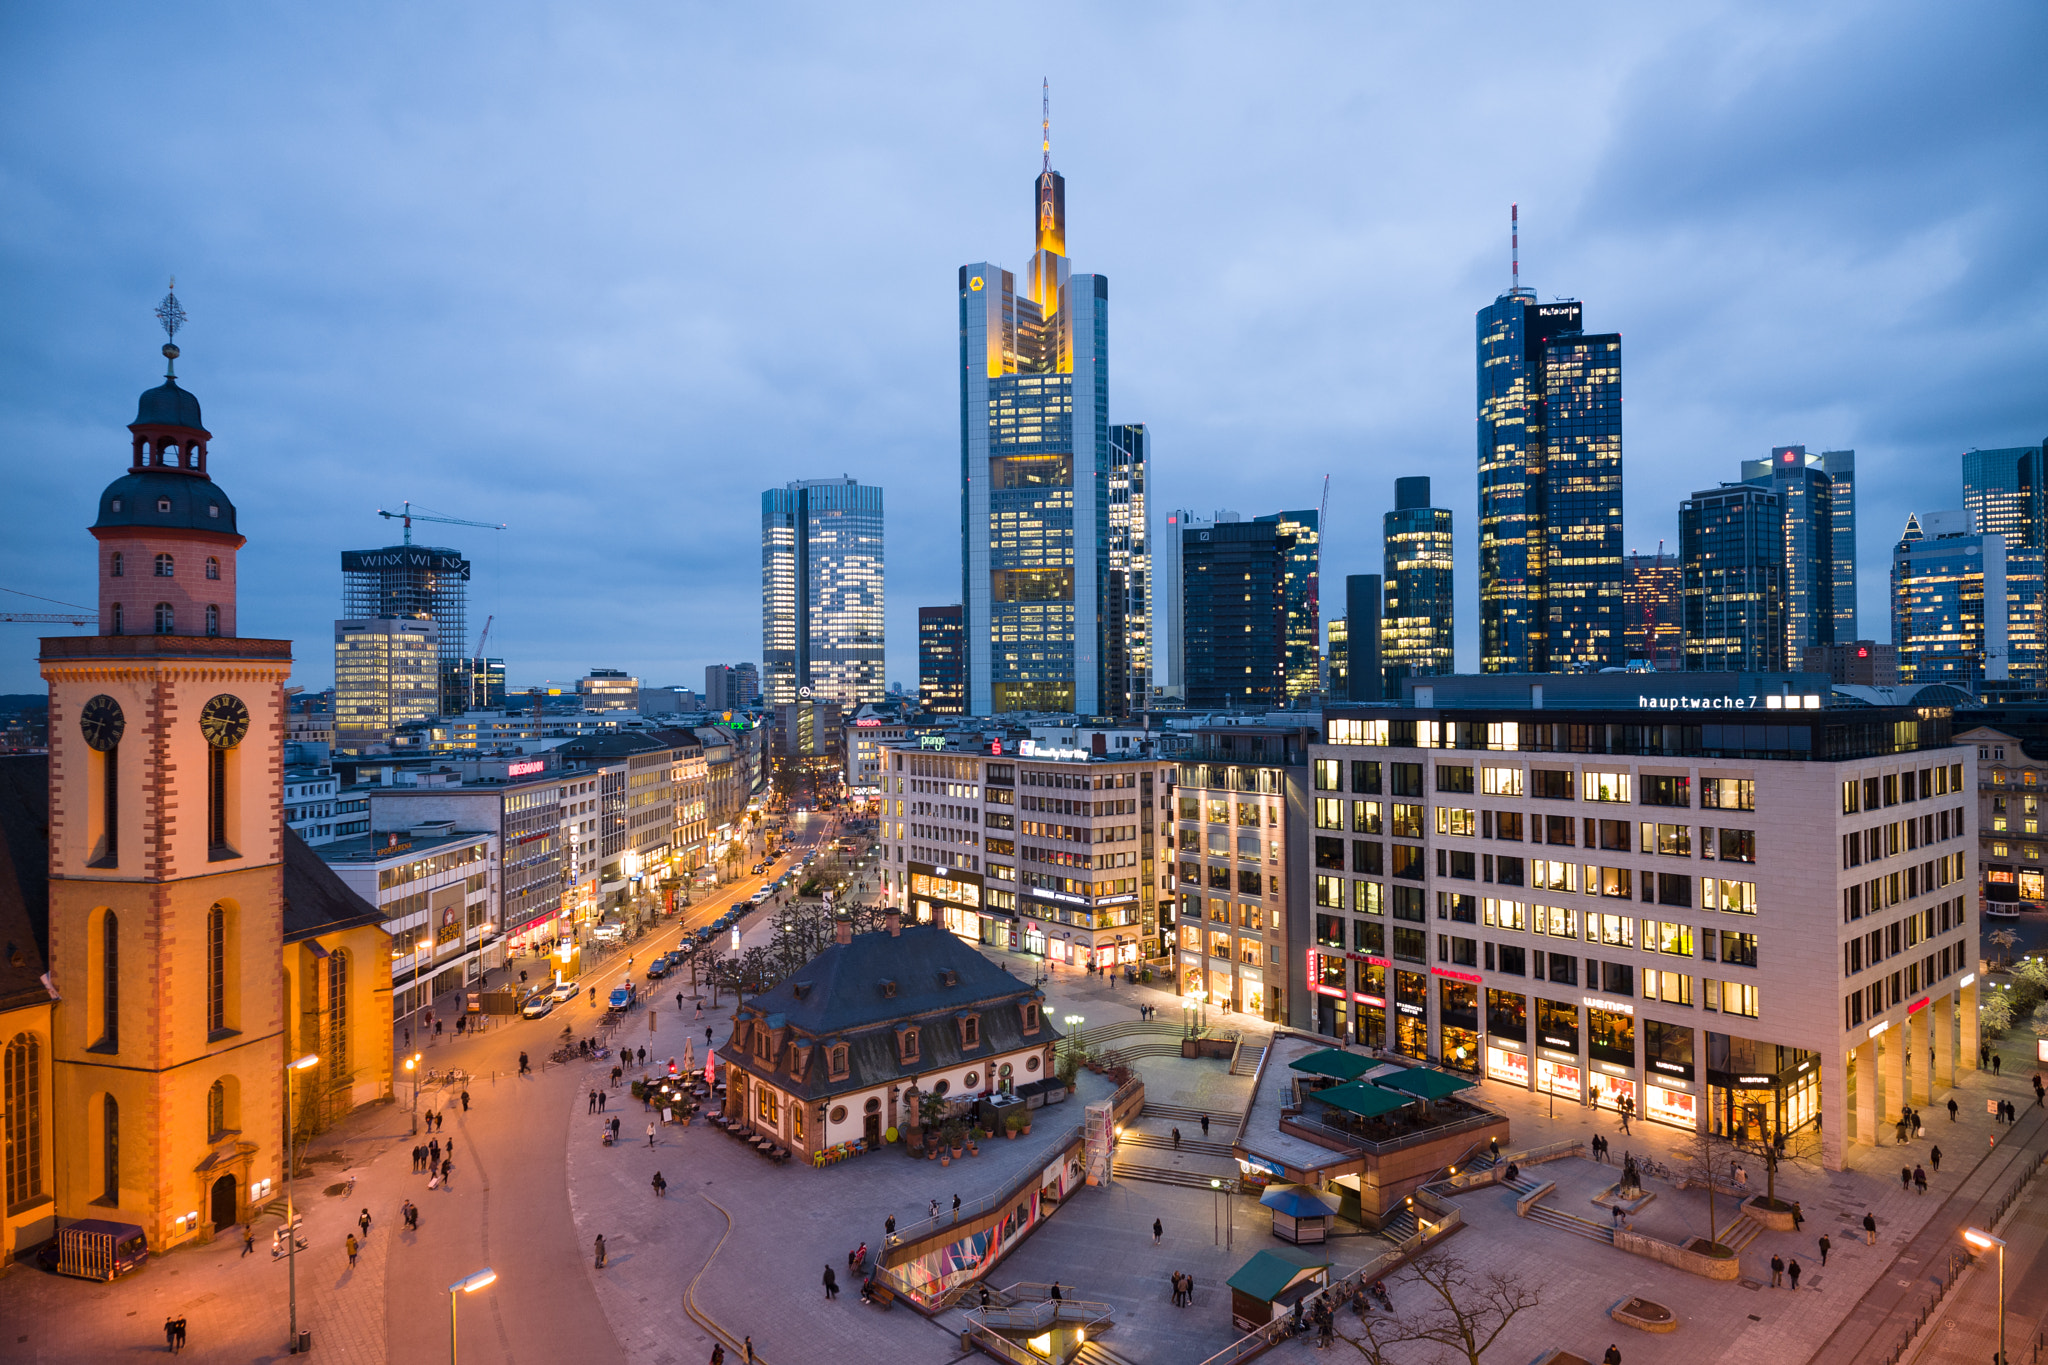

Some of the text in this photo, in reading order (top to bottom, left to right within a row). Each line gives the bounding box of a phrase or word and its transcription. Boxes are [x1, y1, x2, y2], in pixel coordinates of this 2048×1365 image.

[361, 553, 402, 567] WINX
[921, 736, 946, 751] prange
[508, 760, 544, 777] ROSSMANN
[377, 842, 412, 856] SPORTARENA
[441, 921, 461, 937] SPORT
[441, 932, 462, 945] ARENA
[1431, 966, 1482, 983] MAREDO
[1583, 996, 1634, 1014] WEMPE
